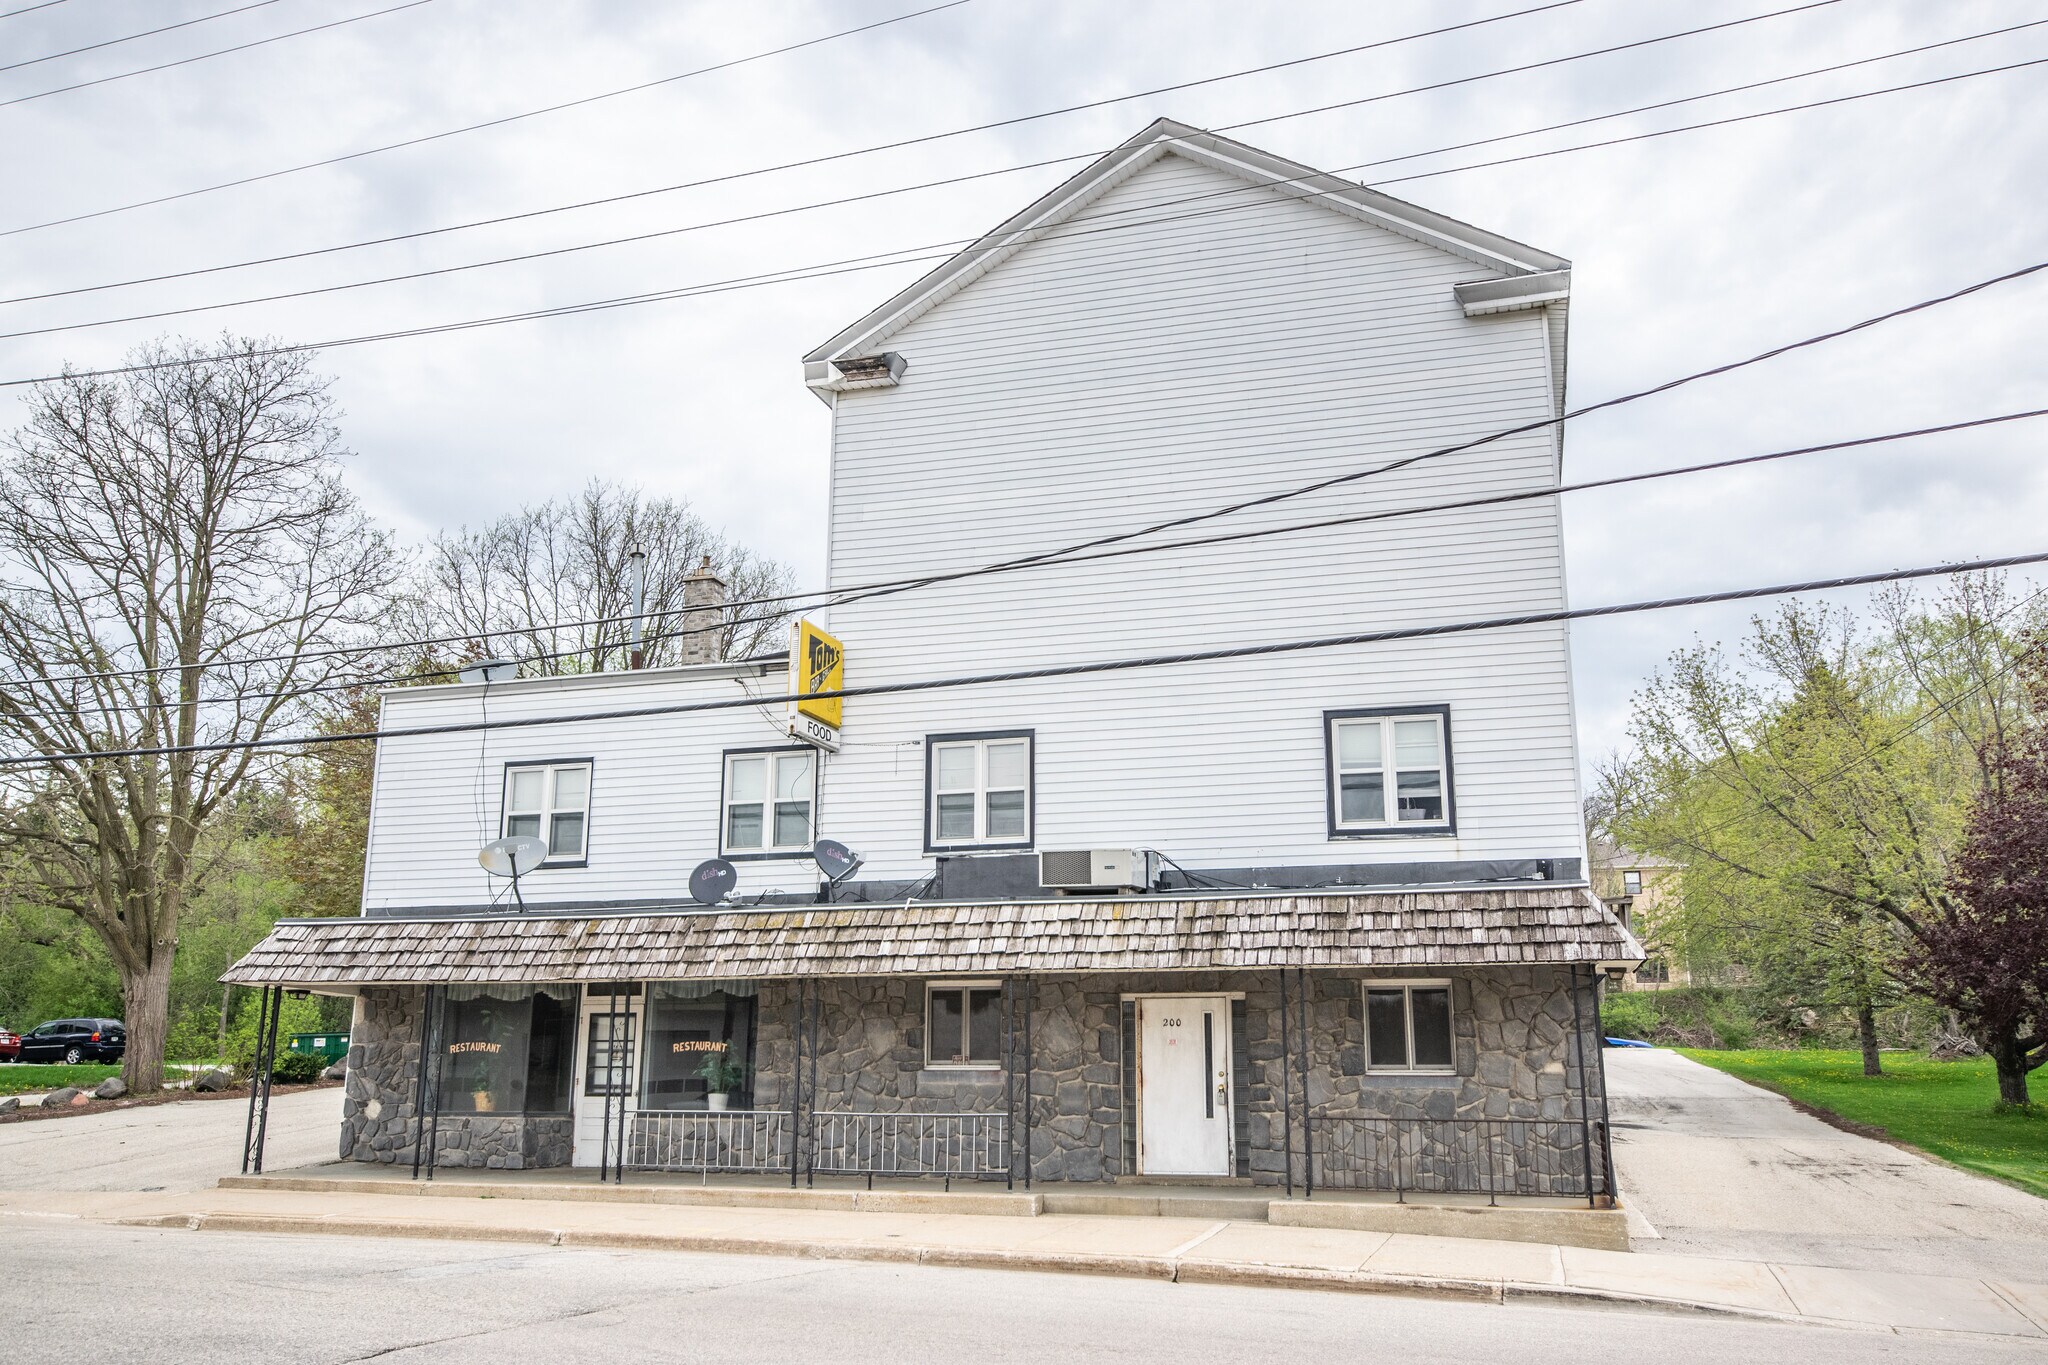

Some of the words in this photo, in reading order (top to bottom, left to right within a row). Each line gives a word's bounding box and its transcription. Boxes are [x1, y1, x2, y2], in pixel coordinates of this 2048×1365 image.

[809, 633, 840, 676] Tom's
[807, 720, 832, 742] FOOD
[1162, 1018, 1182, 1027] 200
[449, 1041, 502, 1054] RESTAURANT
[672, 1041, 728, 1053] RESTAURANT
